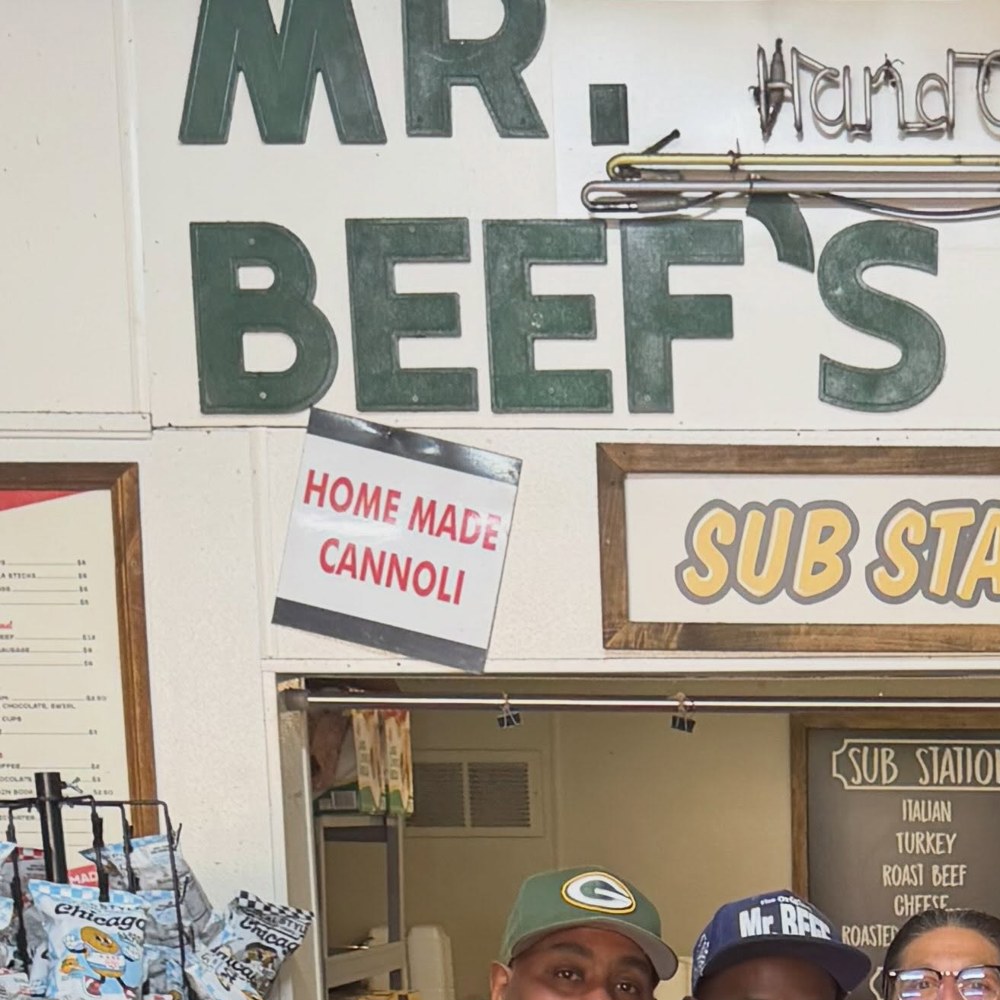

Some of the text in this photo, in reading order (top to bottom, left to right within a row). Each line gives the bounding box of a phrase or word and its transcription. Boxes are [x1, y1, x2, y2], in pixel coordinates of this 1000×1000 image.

[178, 0, 630, 146] MR.
[750, 38, 955, 141] Hand
[303, 469, 502, 551] HOME MADE
[319, 538, 466, 605] CANNOLI
[675, 499, 860, 604] SUB
[849, 746, 898, 785] SUB
[902, 799, 951, 822] ITALIAN
[896, 832, 957, 855] TURKEY
[883, 864, 967, 886] ROAST BEEF
[55, 903, 146, 931] Chicago
